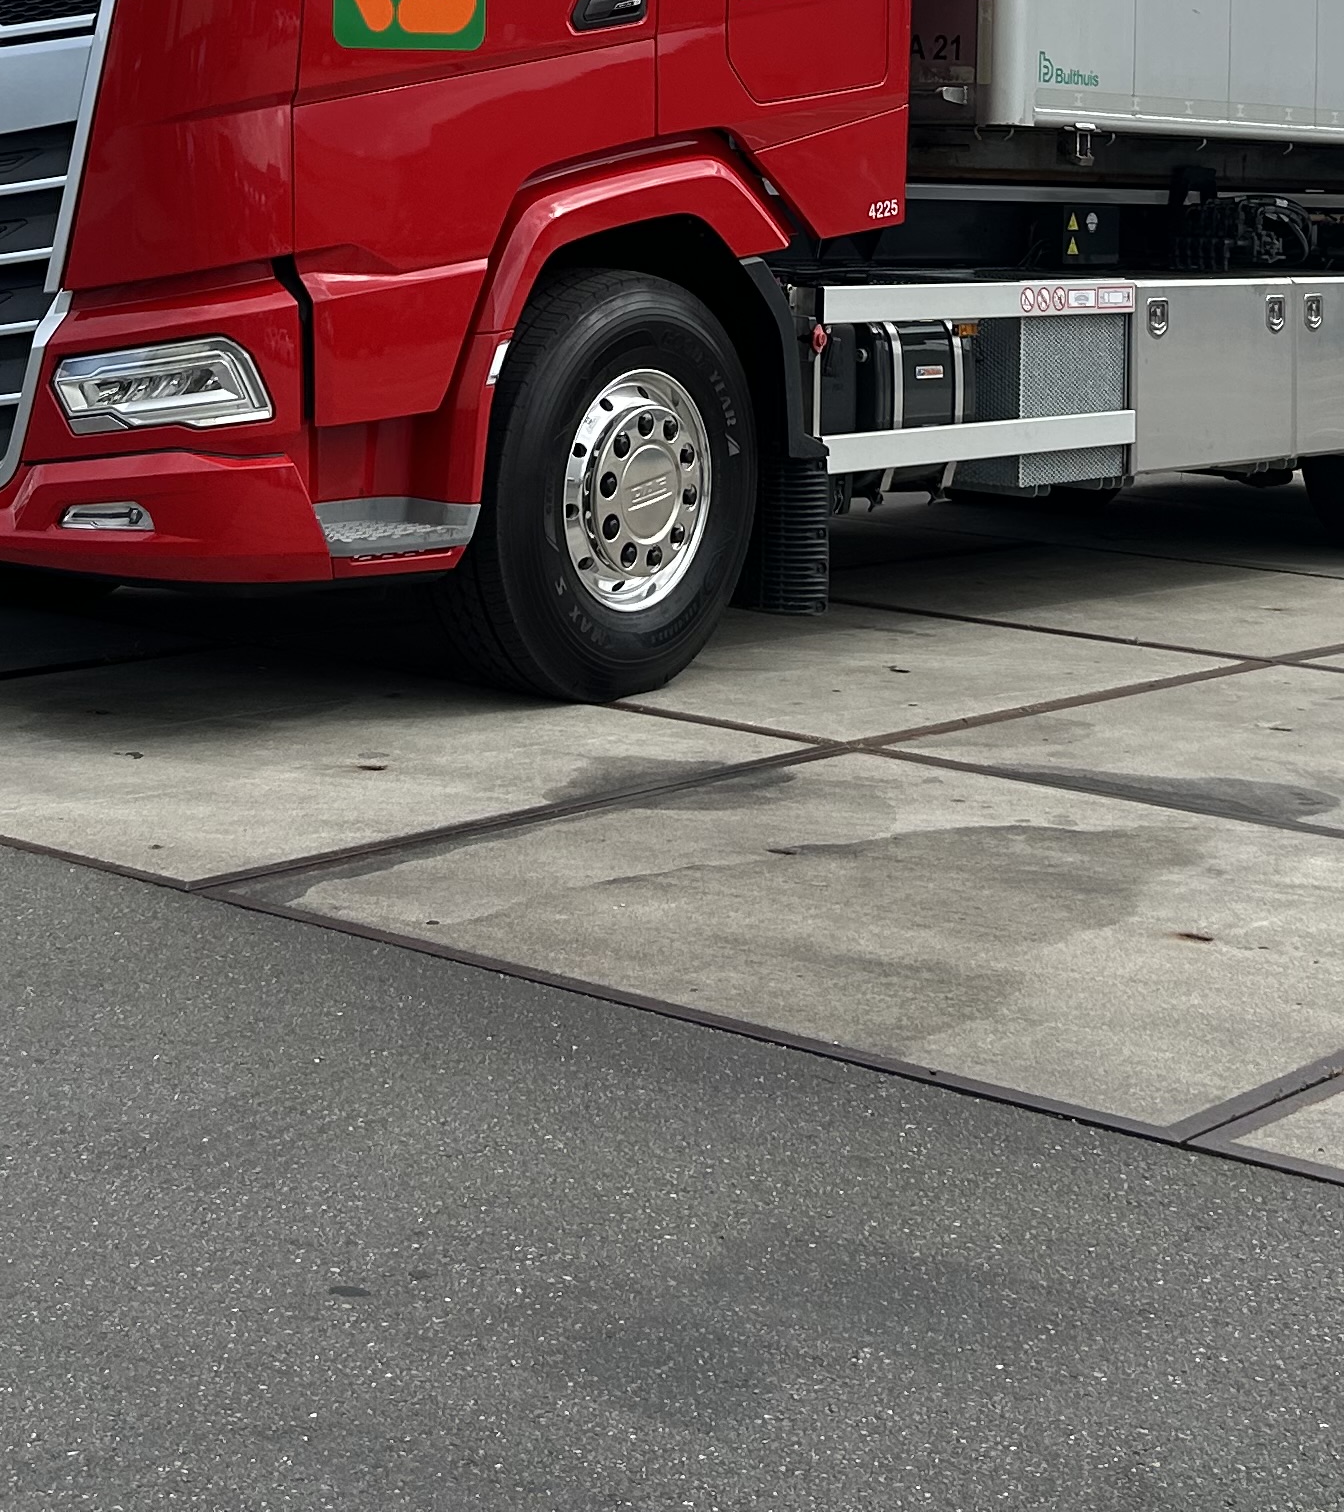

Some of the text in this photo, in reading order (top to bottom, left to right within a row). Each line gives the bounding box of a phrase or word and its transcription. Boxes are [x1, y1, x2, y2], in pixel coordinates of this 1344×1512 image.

[933, 34, 961, 60] 21
[1055, 68, 1099, 87] Bulthuis
[868, 199, 899, 219] 4225
